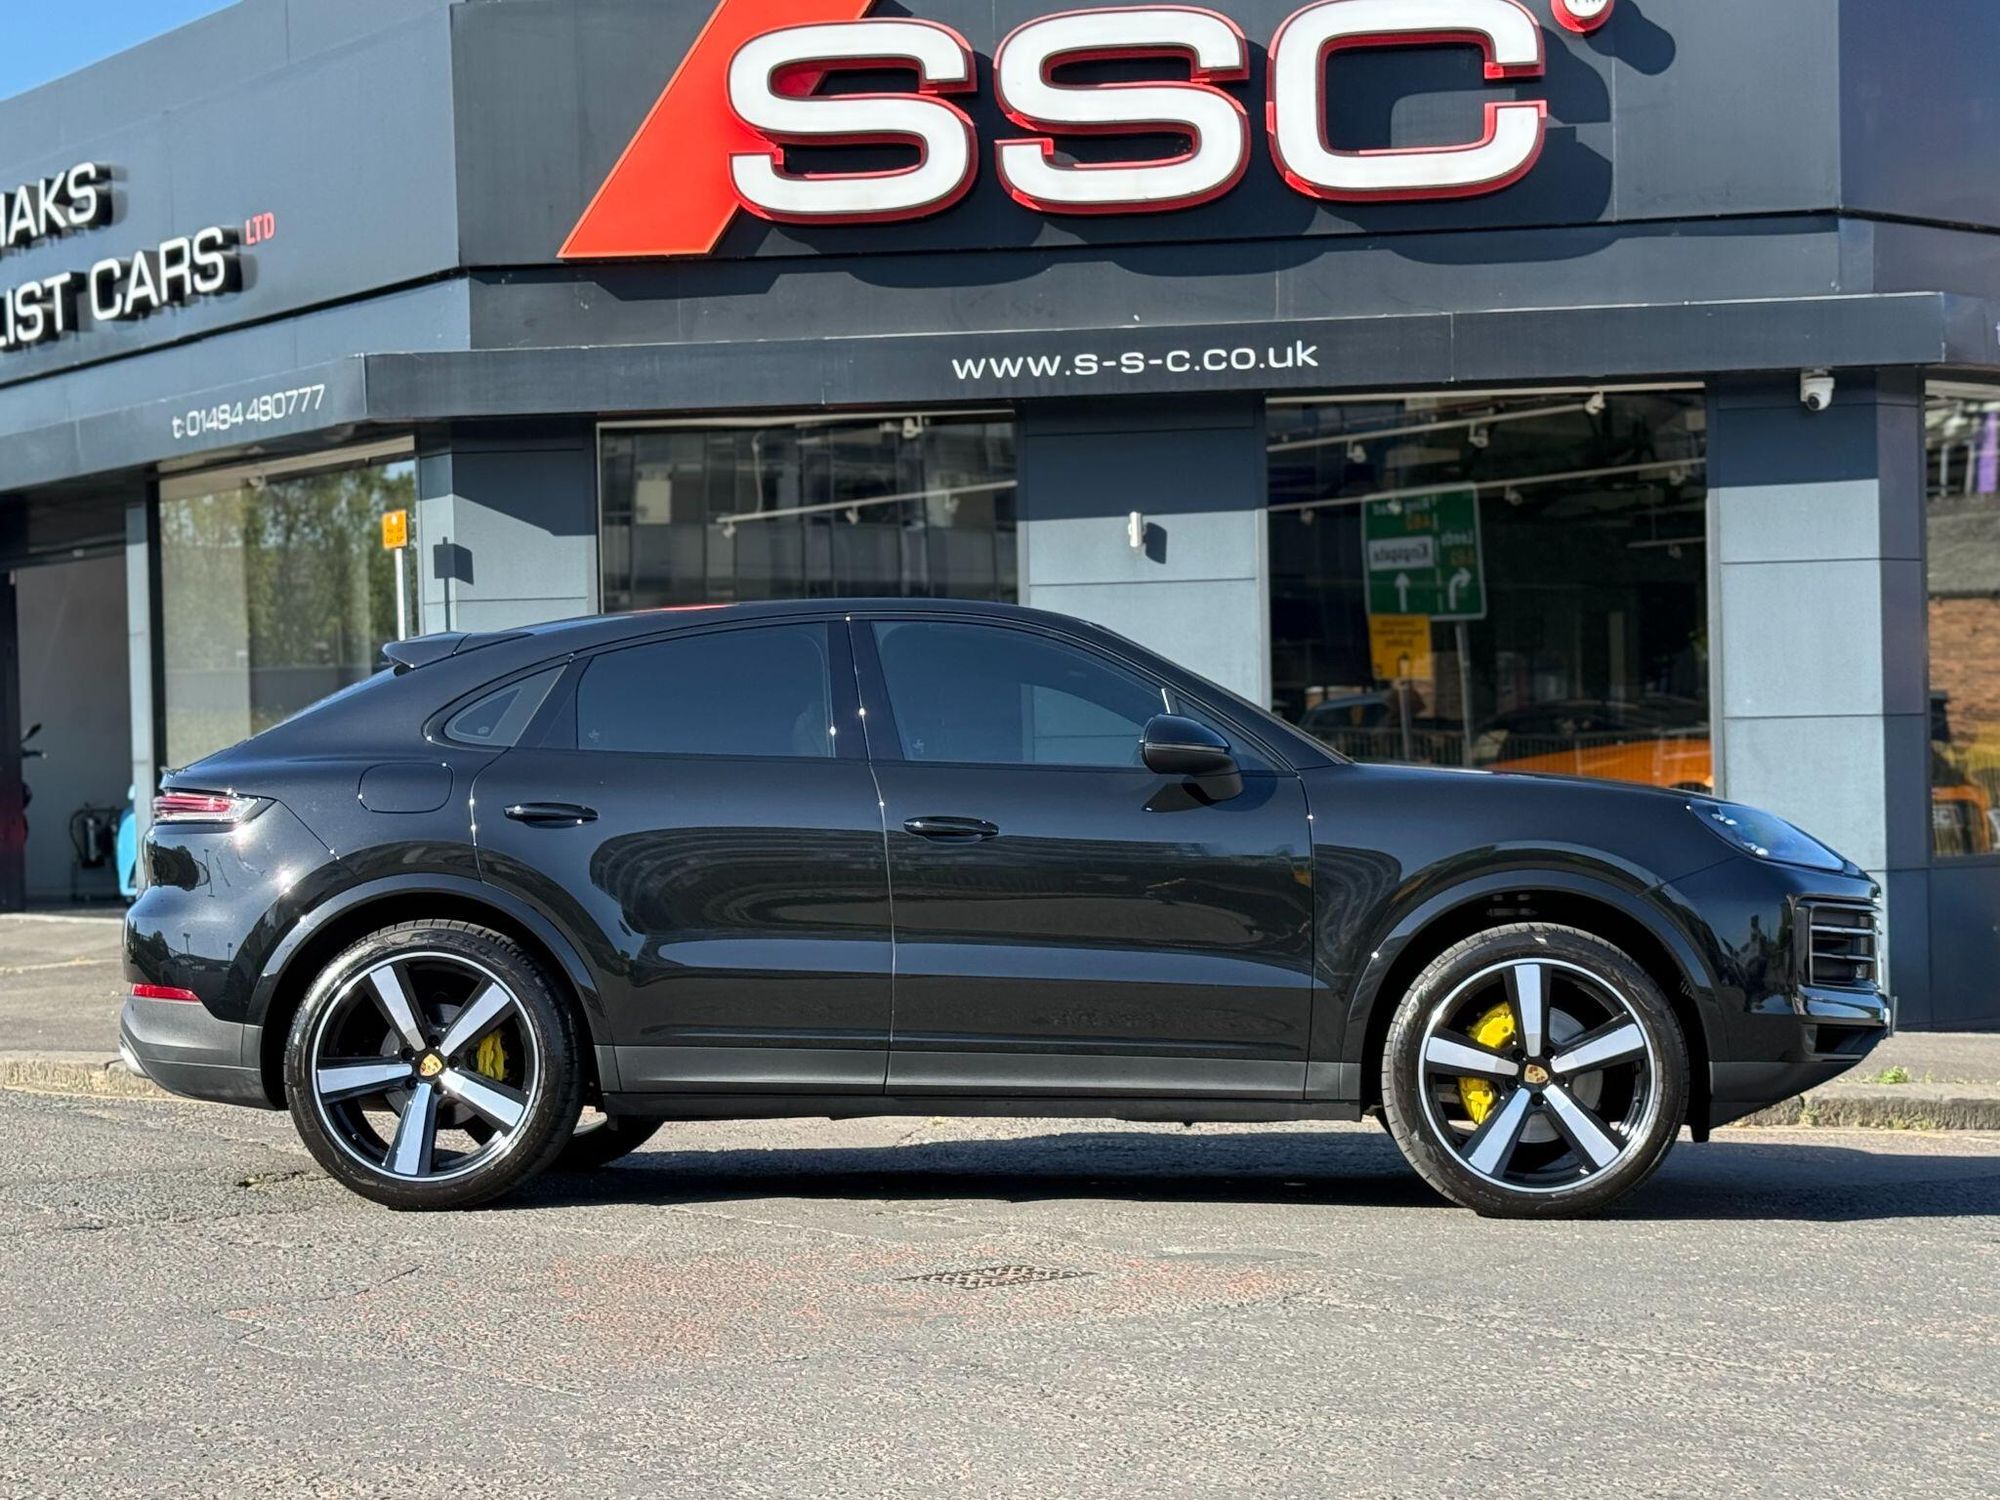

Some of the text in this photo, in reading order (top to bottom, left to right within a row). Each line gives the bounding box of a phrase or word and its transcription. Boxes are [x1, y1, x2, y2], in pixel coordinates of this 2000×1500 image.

[727, 0, 1547, 222] SSC
[245, 211, 275, 246] LTD
[90, 226, 226, 320] CARS
[951, 340, 1319, 380] www.s-s-c.co.uk
